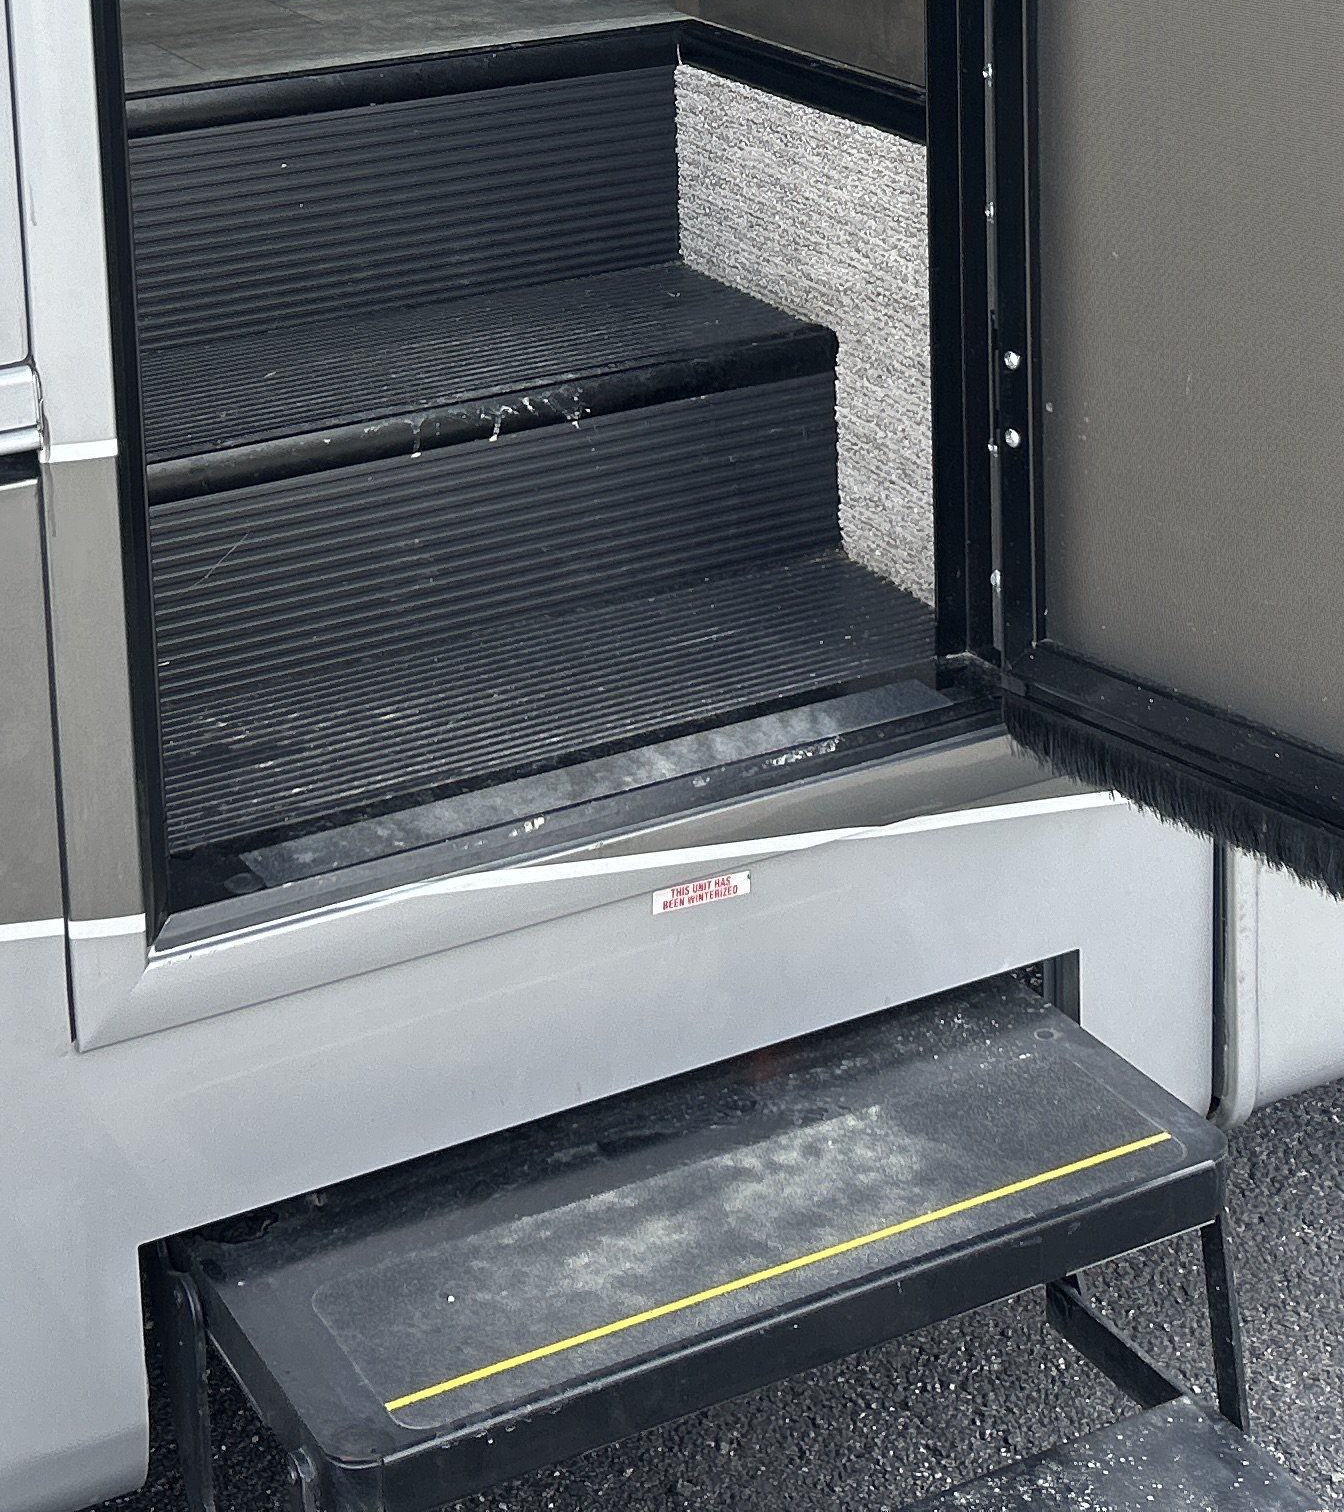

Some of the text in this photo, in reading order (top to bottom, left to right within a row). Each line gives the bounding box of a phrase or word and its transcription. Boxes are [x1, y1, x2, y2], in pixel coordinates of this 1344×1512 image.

[663, 885, 738, 910] BEEN WINTERIZED
[671, 876, 731, 899] THIS UNIT HAS
